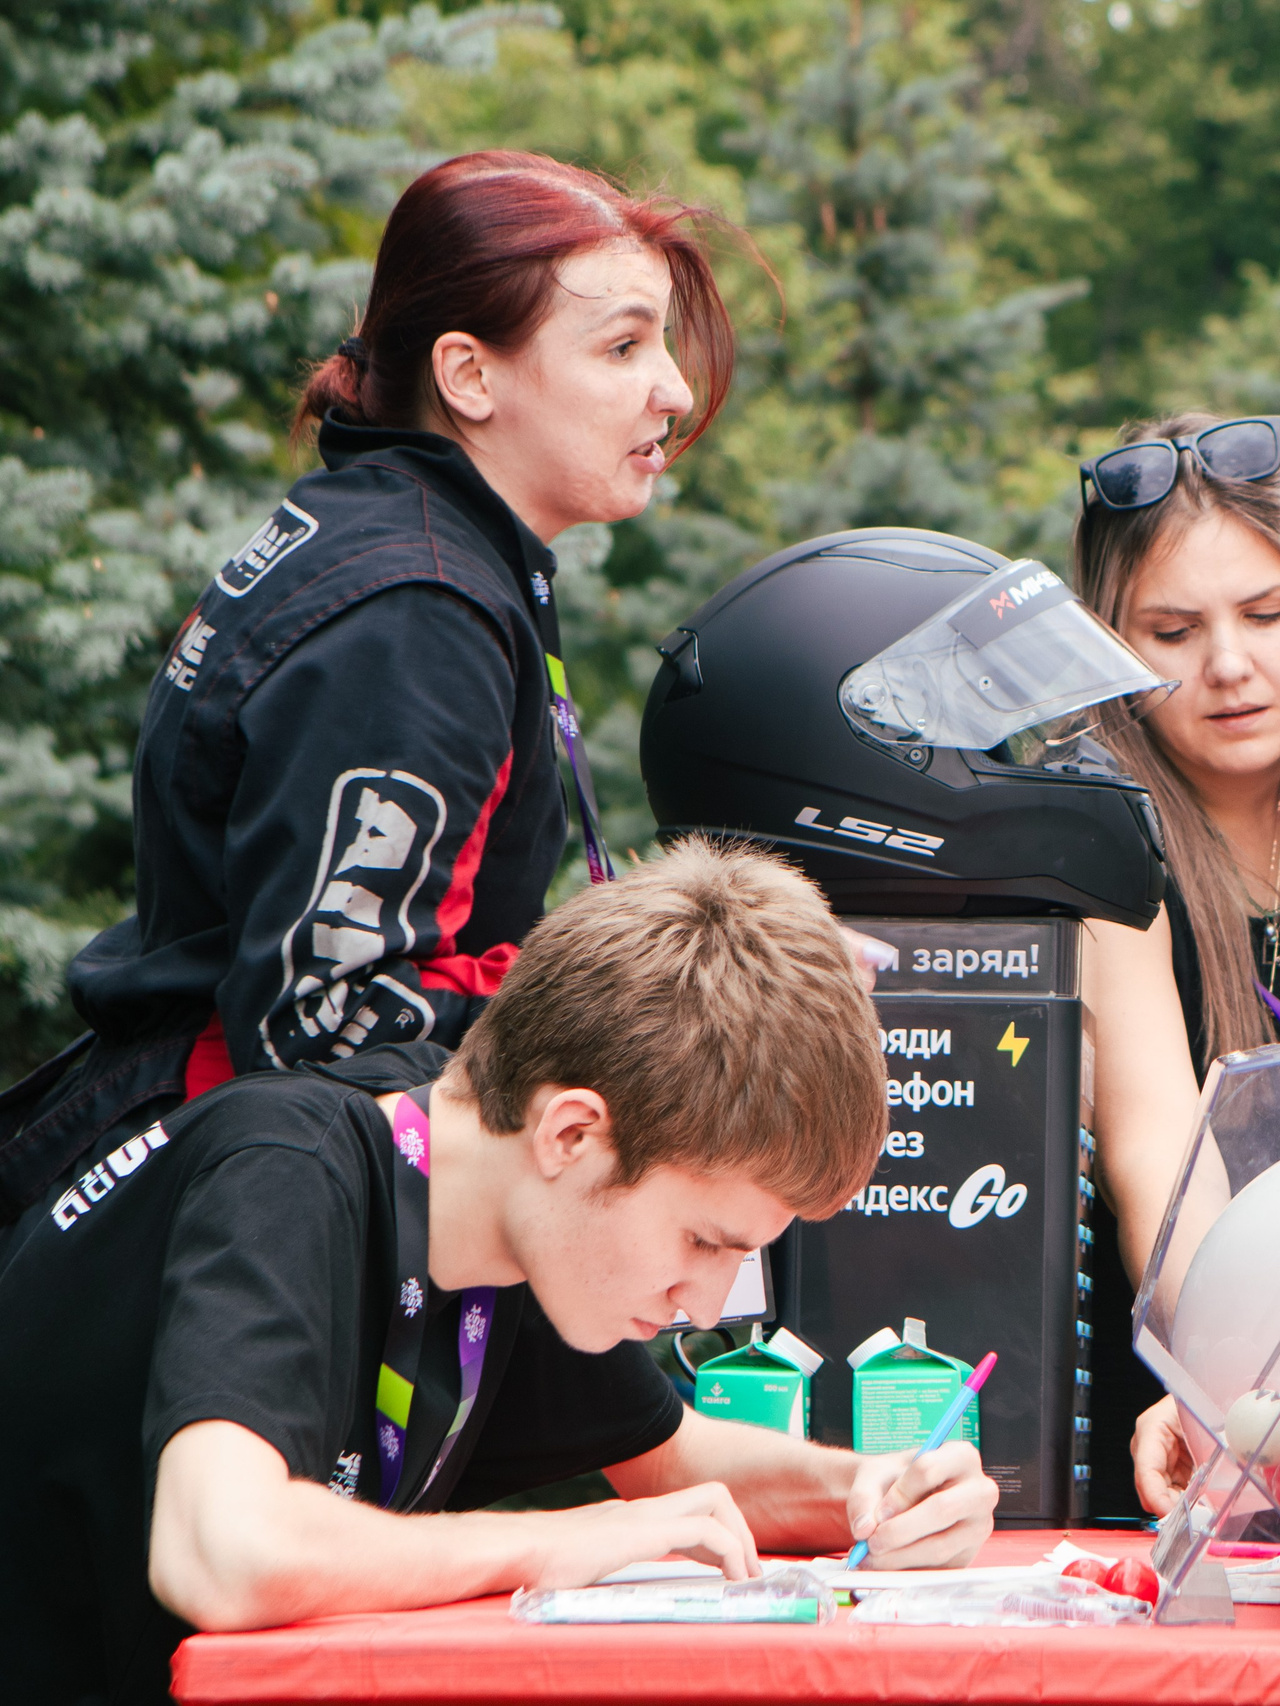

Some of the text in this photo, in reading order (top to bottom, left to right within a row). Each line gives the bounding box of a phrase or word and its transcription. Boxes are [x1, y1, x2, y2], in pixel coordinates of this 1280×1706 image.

[794, 806, 945, 857] LS2
[912, 944, 1039, 979] заряд!
[886, 1071, 975, 1113] ефон
[844, 1163, 1028, 1229] ндекс Go
